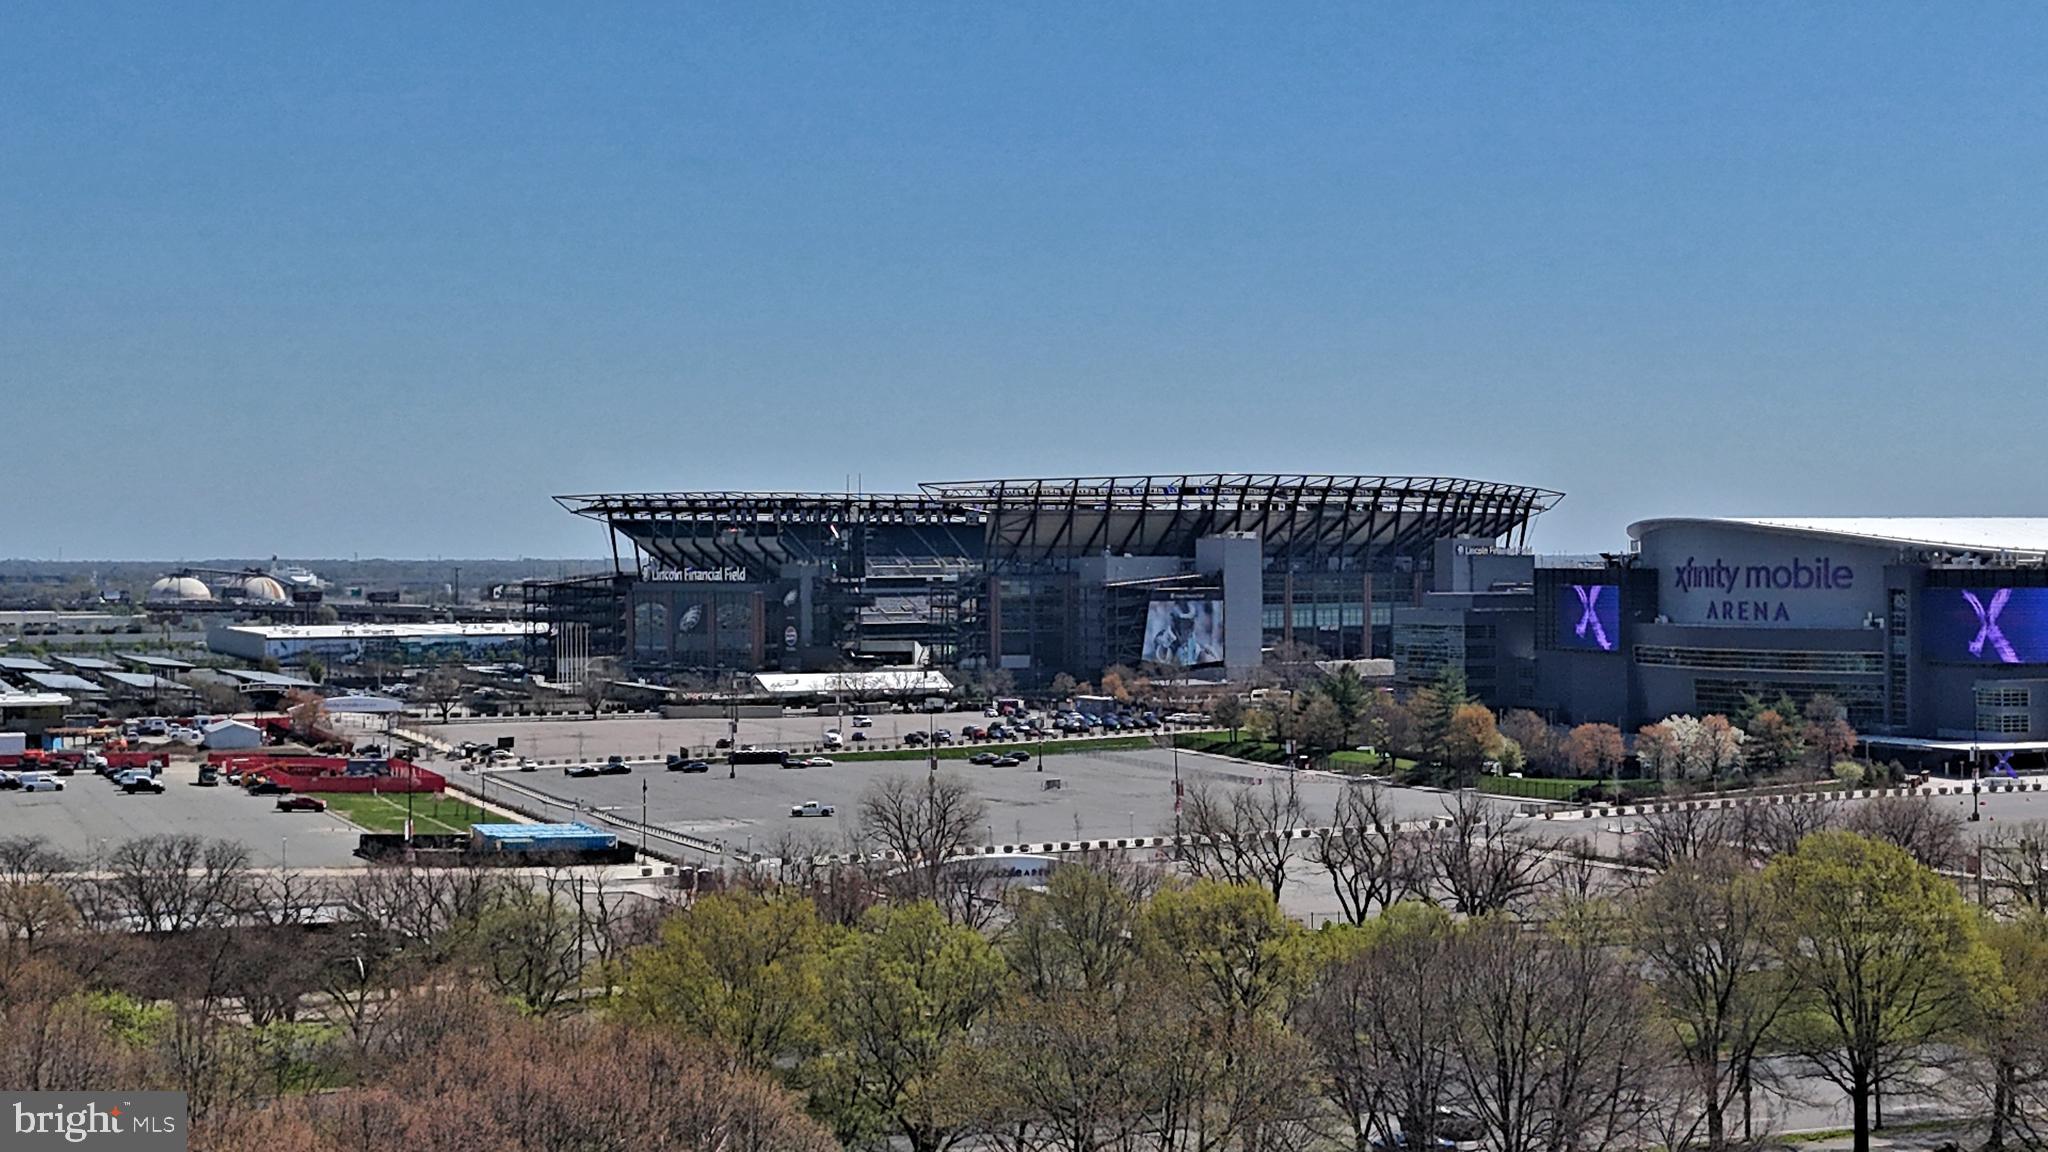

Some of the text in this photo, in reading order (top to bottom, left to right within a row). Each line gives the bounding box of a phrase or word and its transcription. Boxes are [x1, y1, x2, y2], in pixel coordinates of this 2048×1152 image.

[652, 567, 746, 581] Lincoln Financial Field
[1675, 556, 1854, 593] xfinity mobile
[1706, 601, 1790, 621] ARENA
